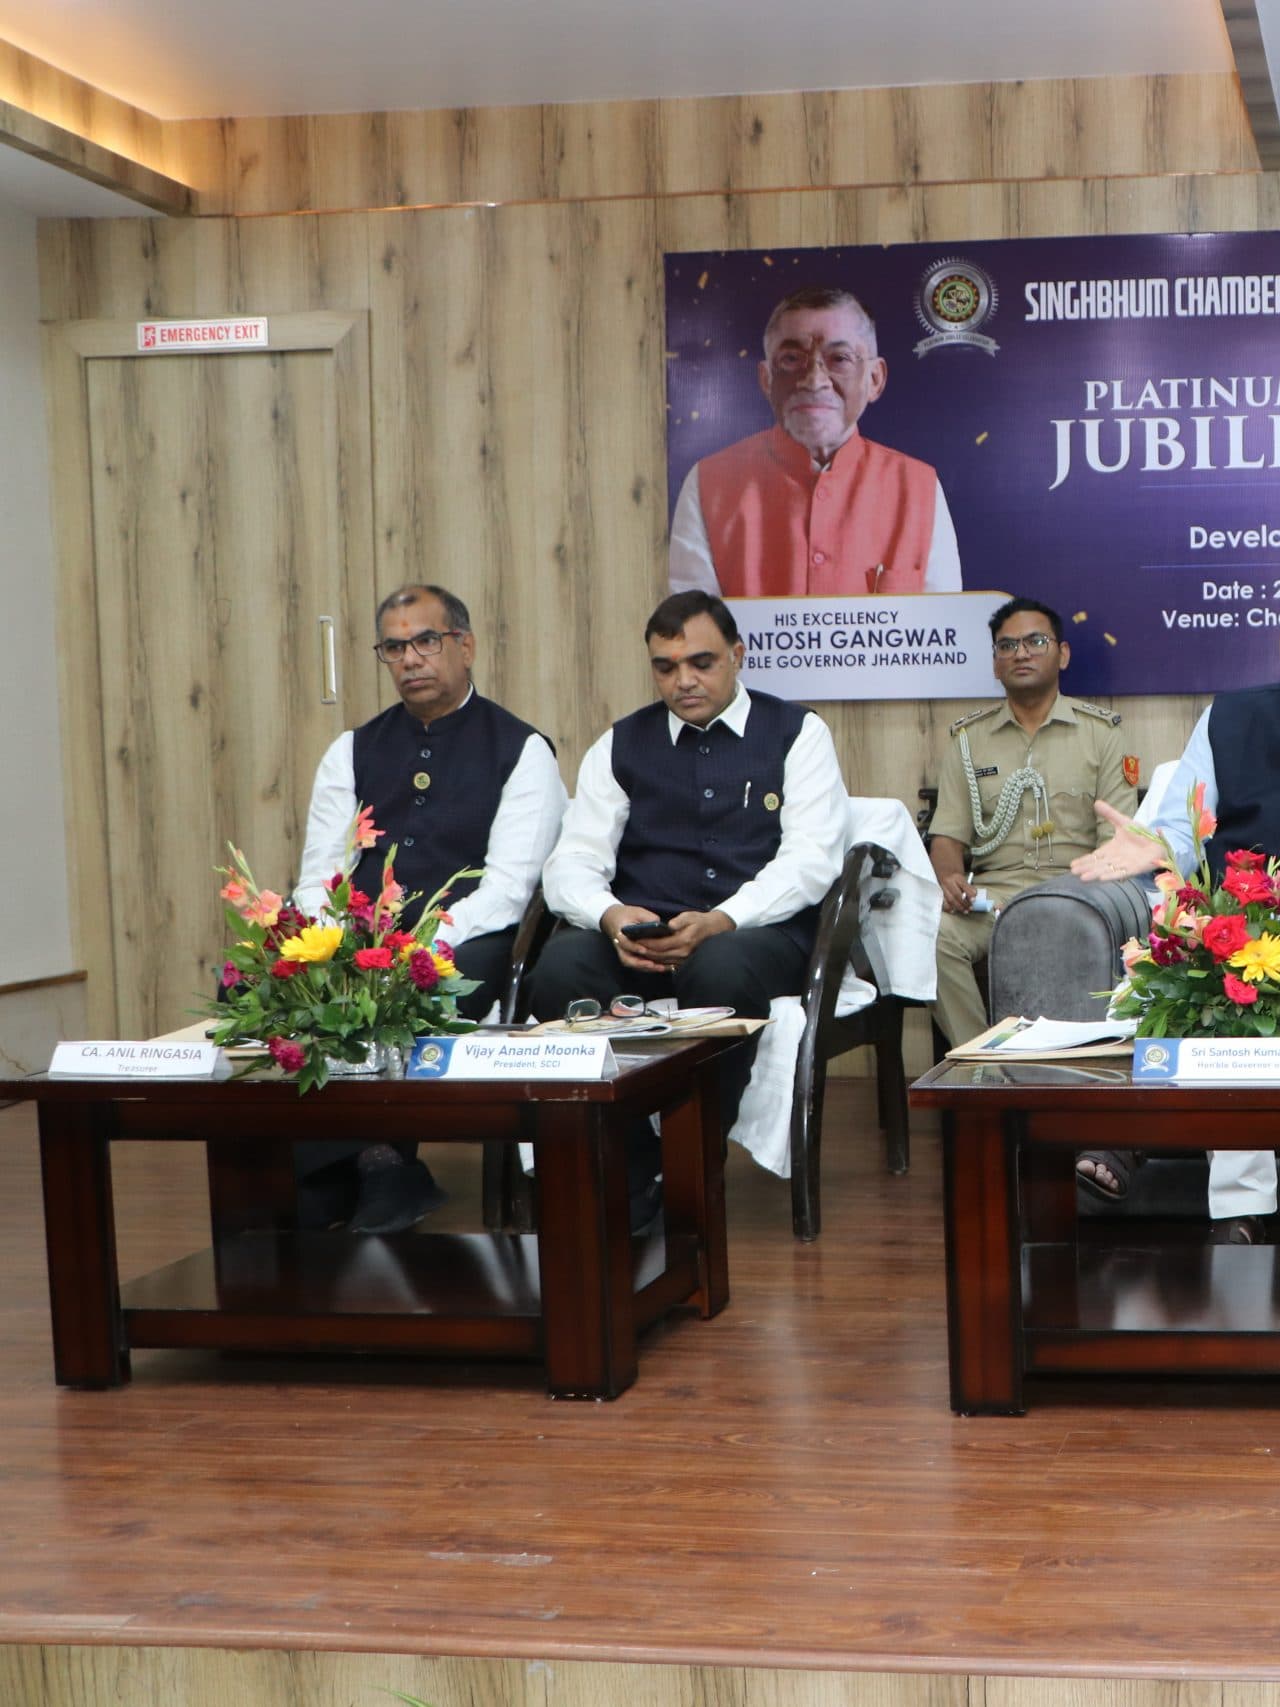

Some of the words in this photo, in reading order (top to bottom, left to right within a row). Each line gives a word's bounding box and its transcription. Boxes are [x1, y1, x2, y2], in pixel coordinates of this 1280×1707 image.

[1024, 278, 1169, 321] SINGHBHUM
[160, 325, 231, 342] EMERGENCY
[234, 324, 260, 339] EXIT
[1202, 580, 1254, 600] Date
[774, 613, 798, 627] HIS
[802, 611, 899, 627] EXCELLENCY
[1161, 608, 1240, 629] Venue:
[739, 631, 822, 651] NTOSH
[830, 628, 957, 649] GANGWAR
[776, 654, 867, 669] GOVERNOR
[871, 651, 968, 667] JHARKHAND
[81, 1046, 102, 1057] CA.
[106, 1047, 136, 1058] ANIL
[139, 1047, 202, 1060] RINGASIA
[465, 1044, 495, 1059] Vijay
[498, 1044, 541, 1056] Anand
[544, 1044, 596, 1056] Moonka
[1191, 1047, 1206, 1057] Sri
[1209, 1047, 1251, 1057] Santosh
[493, 1060, 538, 1069] President,
[540, 1060, 561, 1068] SCCI
